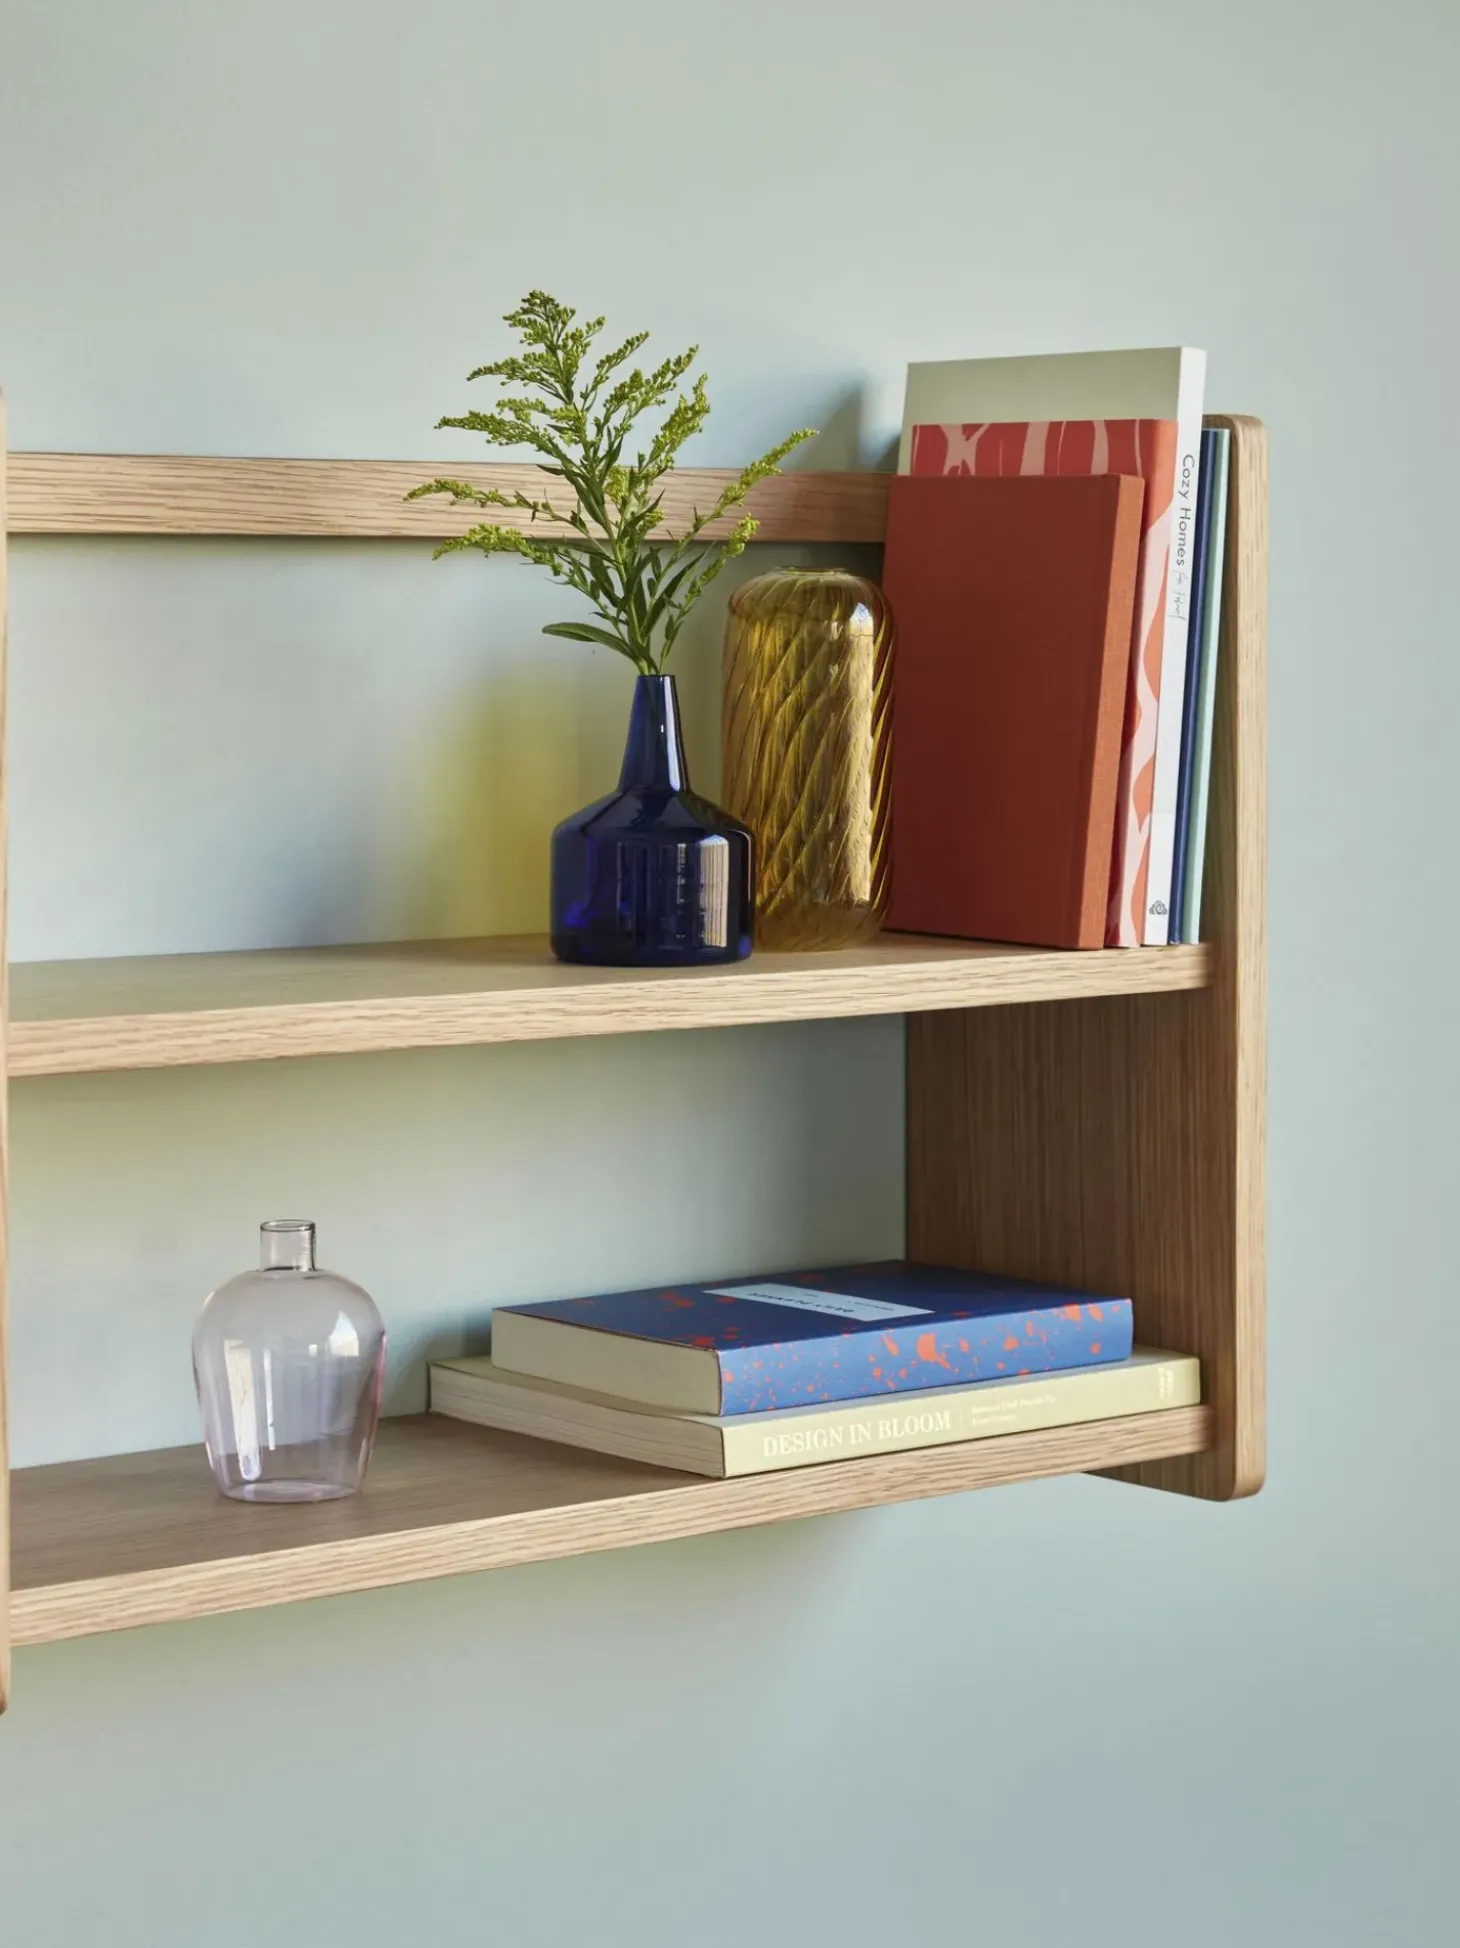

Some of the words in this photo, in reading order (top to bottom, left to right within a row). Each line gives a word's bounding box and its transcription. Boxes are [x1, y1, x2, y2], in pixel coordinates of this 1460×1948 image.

[1178, 454, 1195, 500] Cozy
[1176, 507, 1191, 567] Homes
[763, 1425, 844, 1457] DESIGN
[849, 1422, 874, 1444] IN
[878, 1410, 952, 1440] BLOOM
